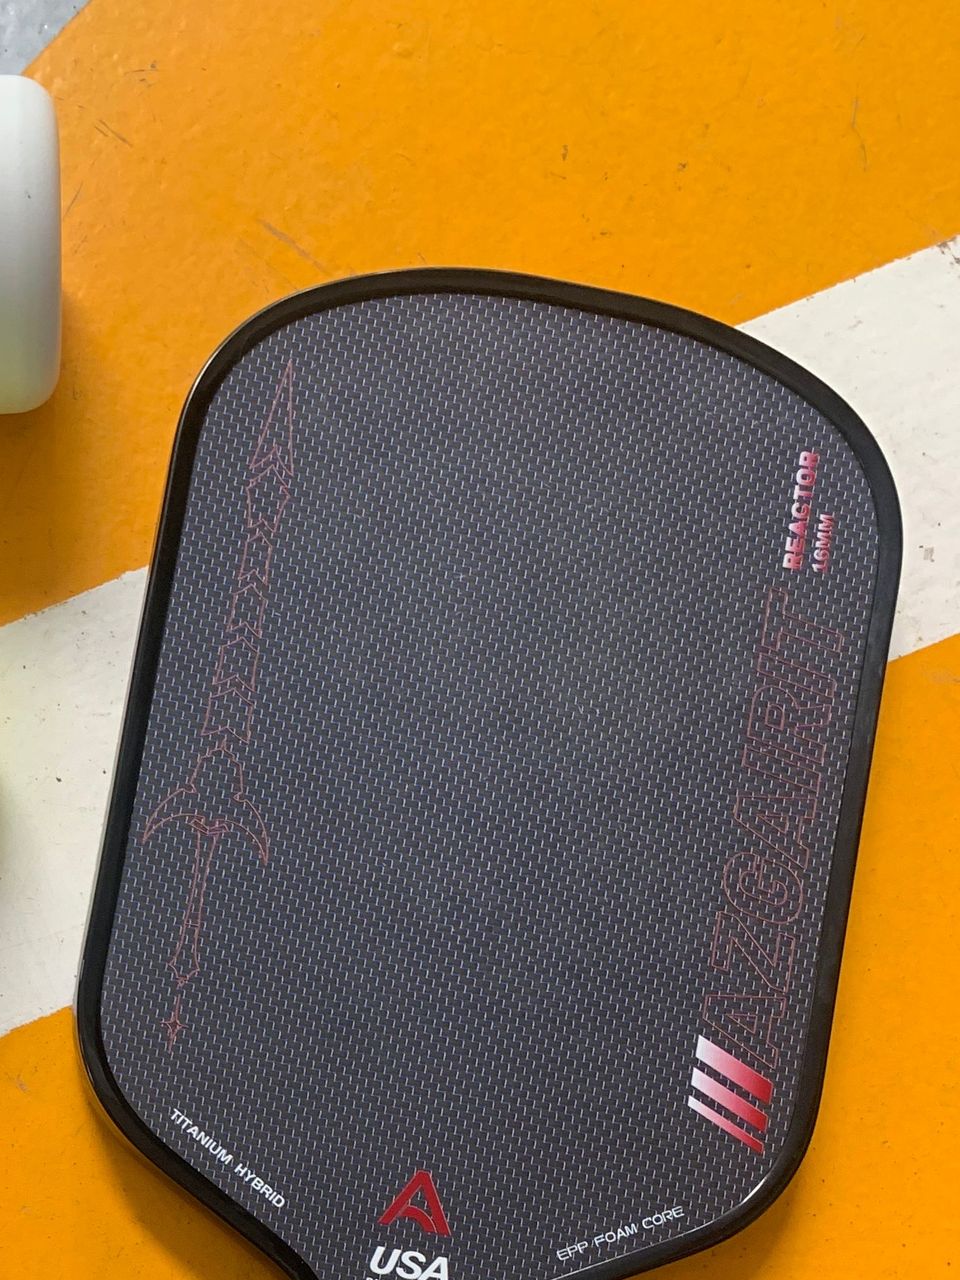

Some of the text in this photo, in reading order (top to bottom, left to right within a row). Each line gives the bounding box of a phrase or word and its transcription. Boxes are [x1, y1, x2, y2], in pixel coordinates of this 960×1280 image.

[782, 450, 820, 572] REACTOR
[811, 513, 834, 574] 16MM
[701, 586, 843, 1070] AZGAIRIT
[170, 1108, 286, 1208] TITANIUM HYBRID
[556, 1205, 685, 1261] EPP FOAM CORE
